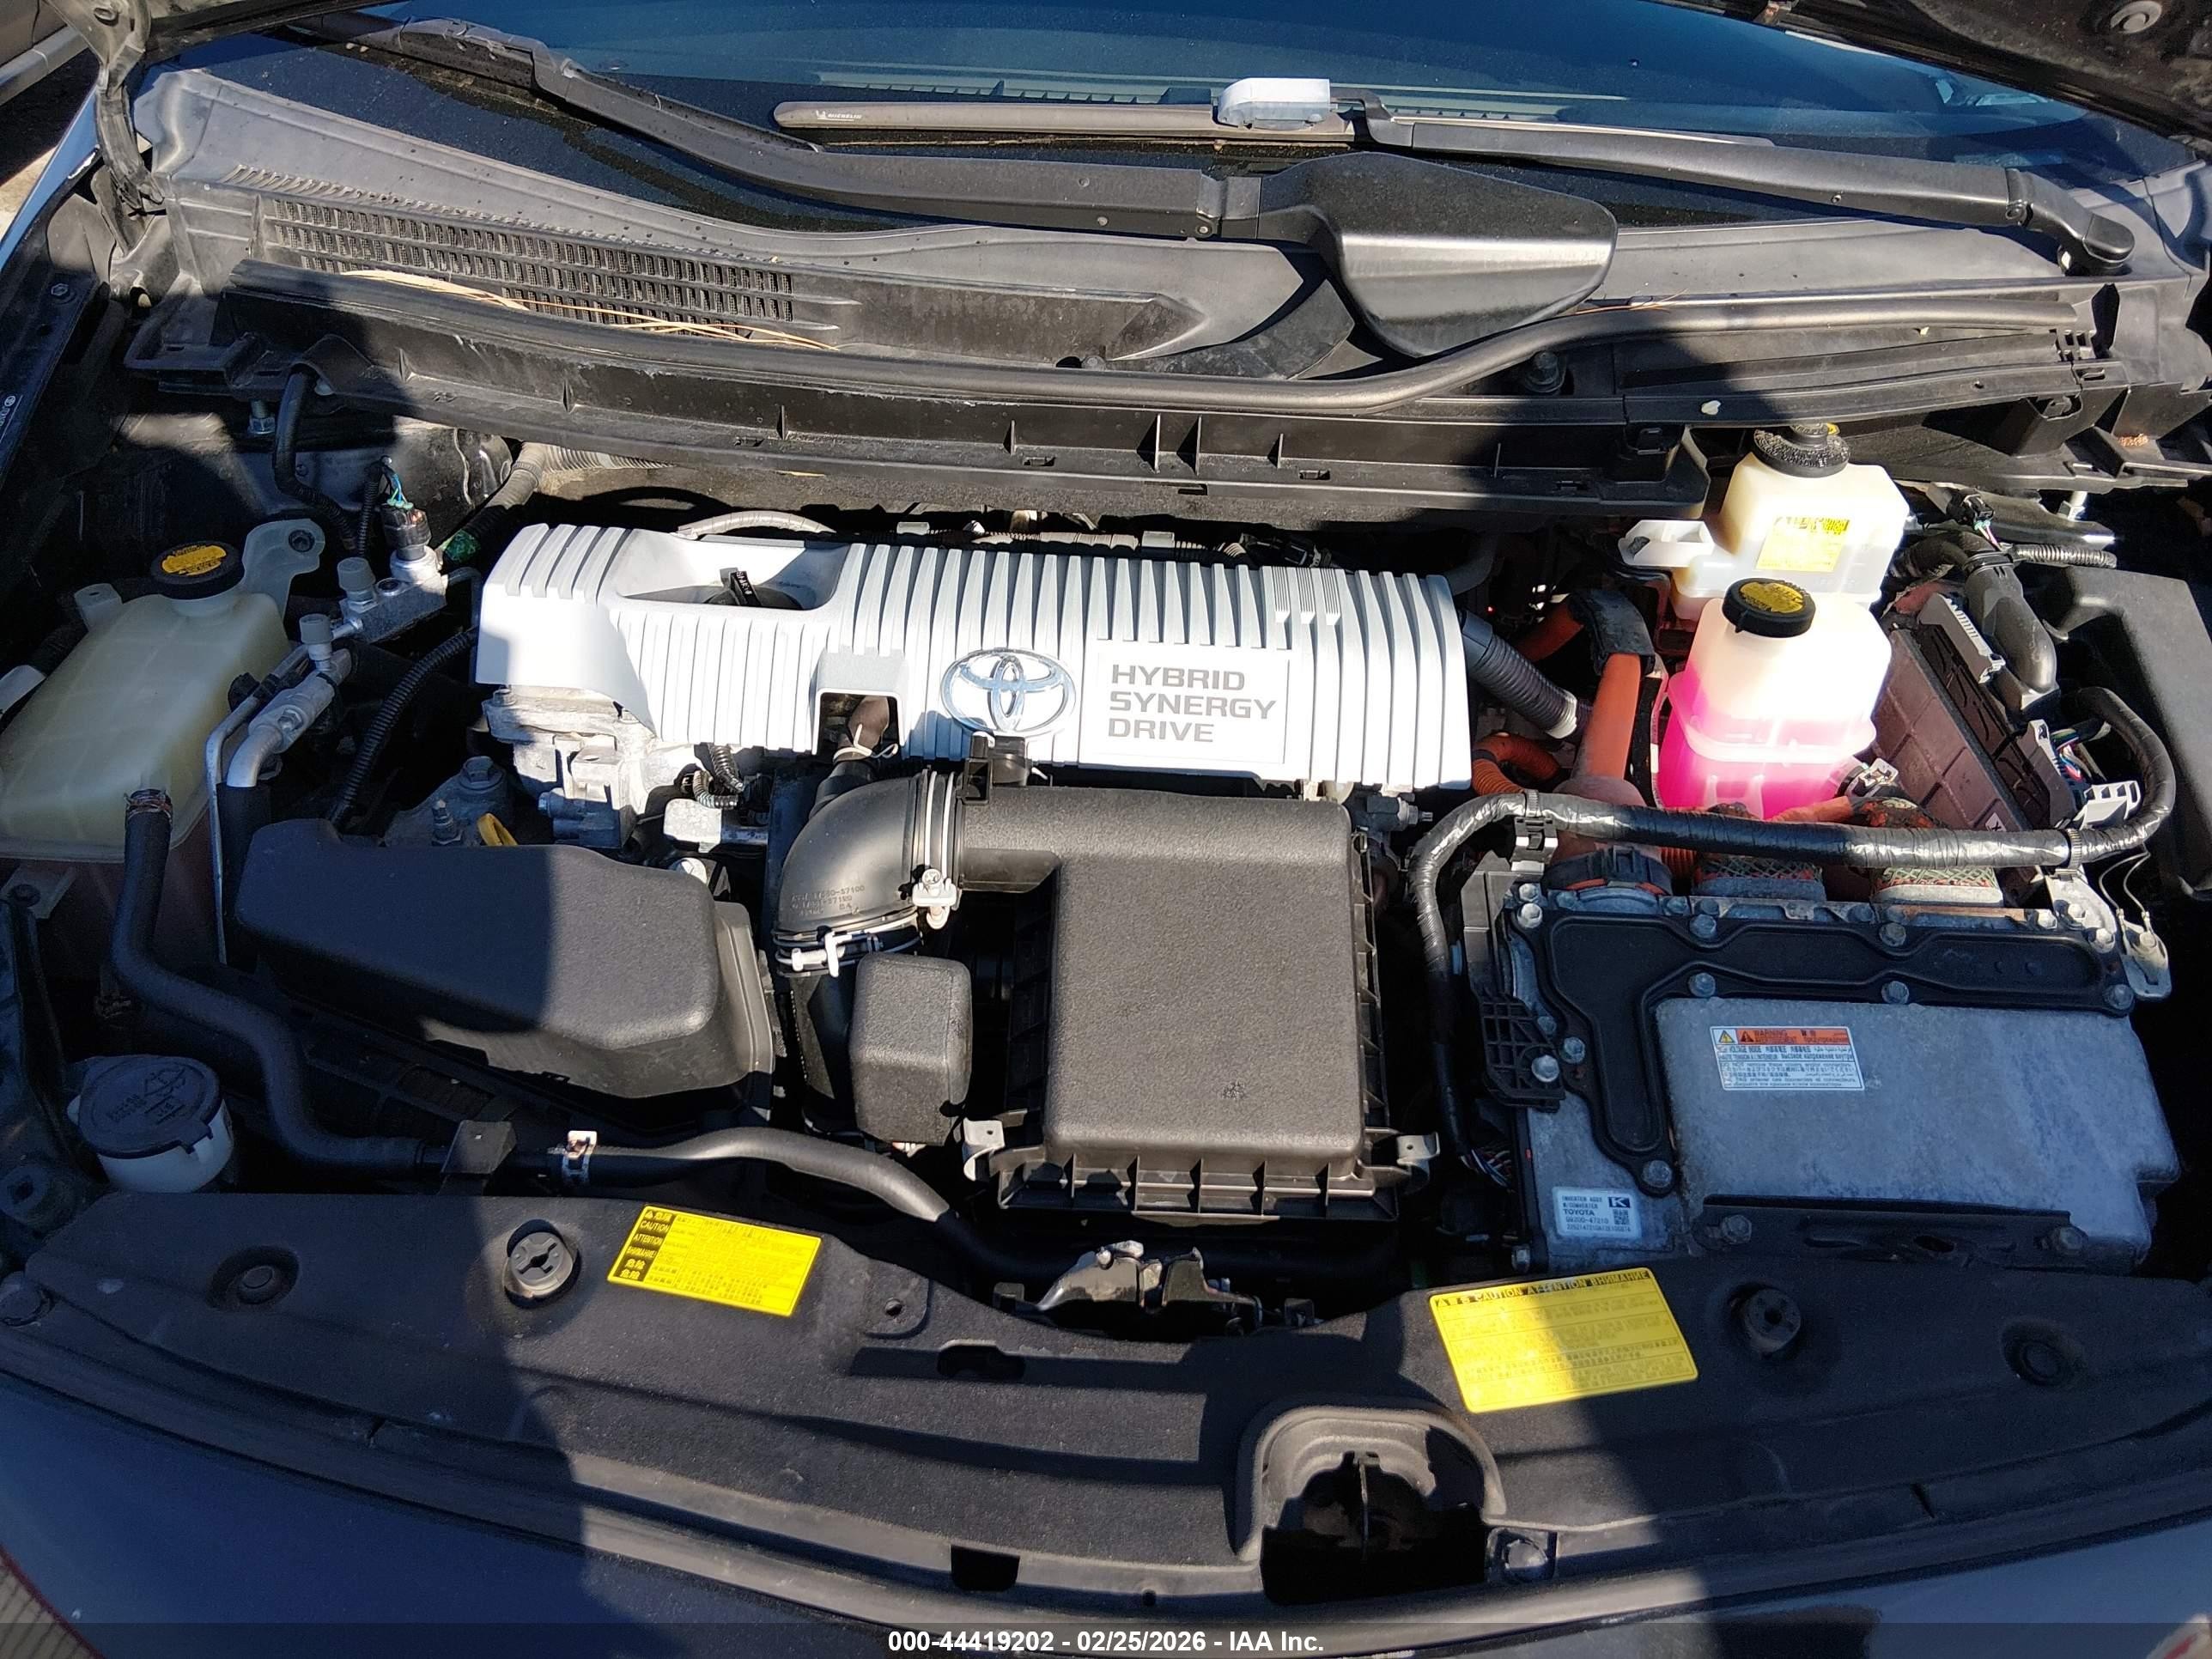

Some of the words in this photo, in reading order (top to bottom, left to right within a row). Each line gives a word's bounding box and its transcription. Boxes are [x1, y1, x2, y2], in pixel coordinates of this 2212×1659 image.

[1112, 665, 1245, 690] HYBRID
[1109, 691, 1276, 720] SYNERGY
[1108, 718, 1214, 742] DRIVE
[640, 1220, 671, 1232] CAUTION
[633, 1233, 664, 1245] ATTENTION
[1475, 1287, 1522, 1301] CAUTION
[1528, 1279, 1587, 1295] ATTENTION
[1592, 1270, 1649, 1287] ВНИМАНИЕ
